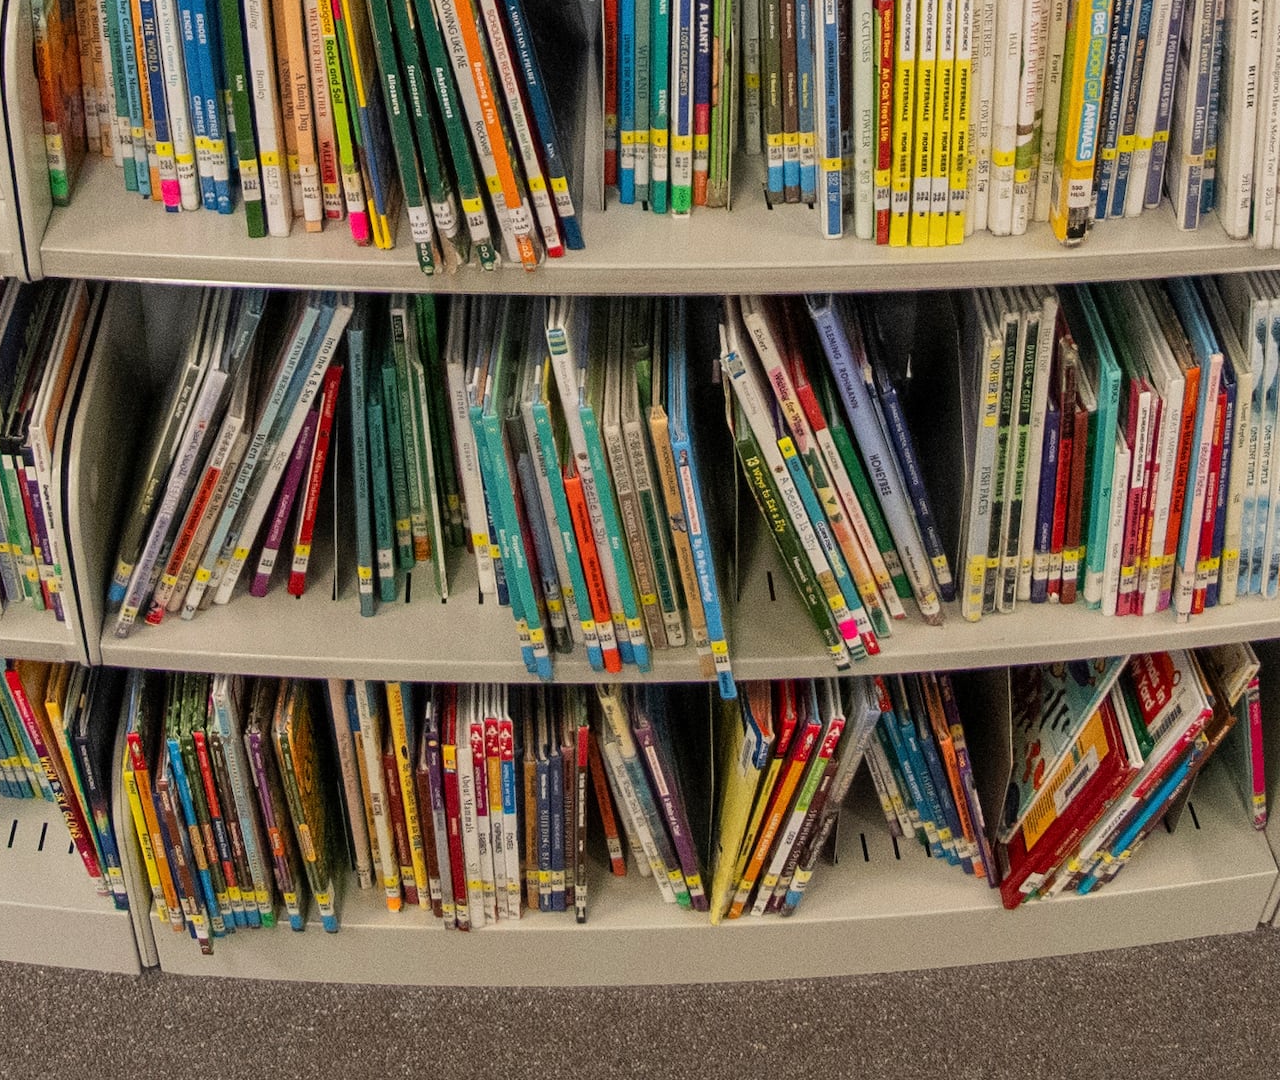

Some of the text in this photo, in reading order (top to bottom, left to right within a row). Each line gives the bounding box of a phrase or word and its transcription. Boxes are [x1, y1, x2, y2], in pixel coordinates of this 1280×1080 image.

[182, 9, 194, 41] BENDER
[699, 3, 710, 13] A
[1091, 11, 1108, 39] BIG
[1251, 9, 1259, 26] AM
[143, 17, 153, 36] THE
[451, 34, 463, 53] LIKE
[698, 15, 711, 55] PLANT?
[146, 36, 158, 74] WORLD
[326, 39, 344, 105] Rocks and Soil
[456, 54, 468, 70] ME
[1087, 37, 1106, 78] BOOK
[235, 74, 244, 93] RAIN
[295, 81, 307, 111] Rainy
[386, 74, 400, 116] Allosaurus
[435, 67, 454, 119] Ankylosaurus
[473, 62, 490, 100] Becoming
[485, 108, 496, 126] Fish
[1246, 65, 1256, 109] BUTLER
[193, 95, 205, 136] CRABTREE
[658, 88, 667, 117] STONE
[297, 111, 310, 133] Day
[1077, 103, 1099, 161] ANIMALS
[753, 328, 768, 352] Ehlert
[823, 325, 843, 361] FLEMING
[869, 452, 892, 497] HONEYBEE
[976, 465, 992, 517] FISH FACES
